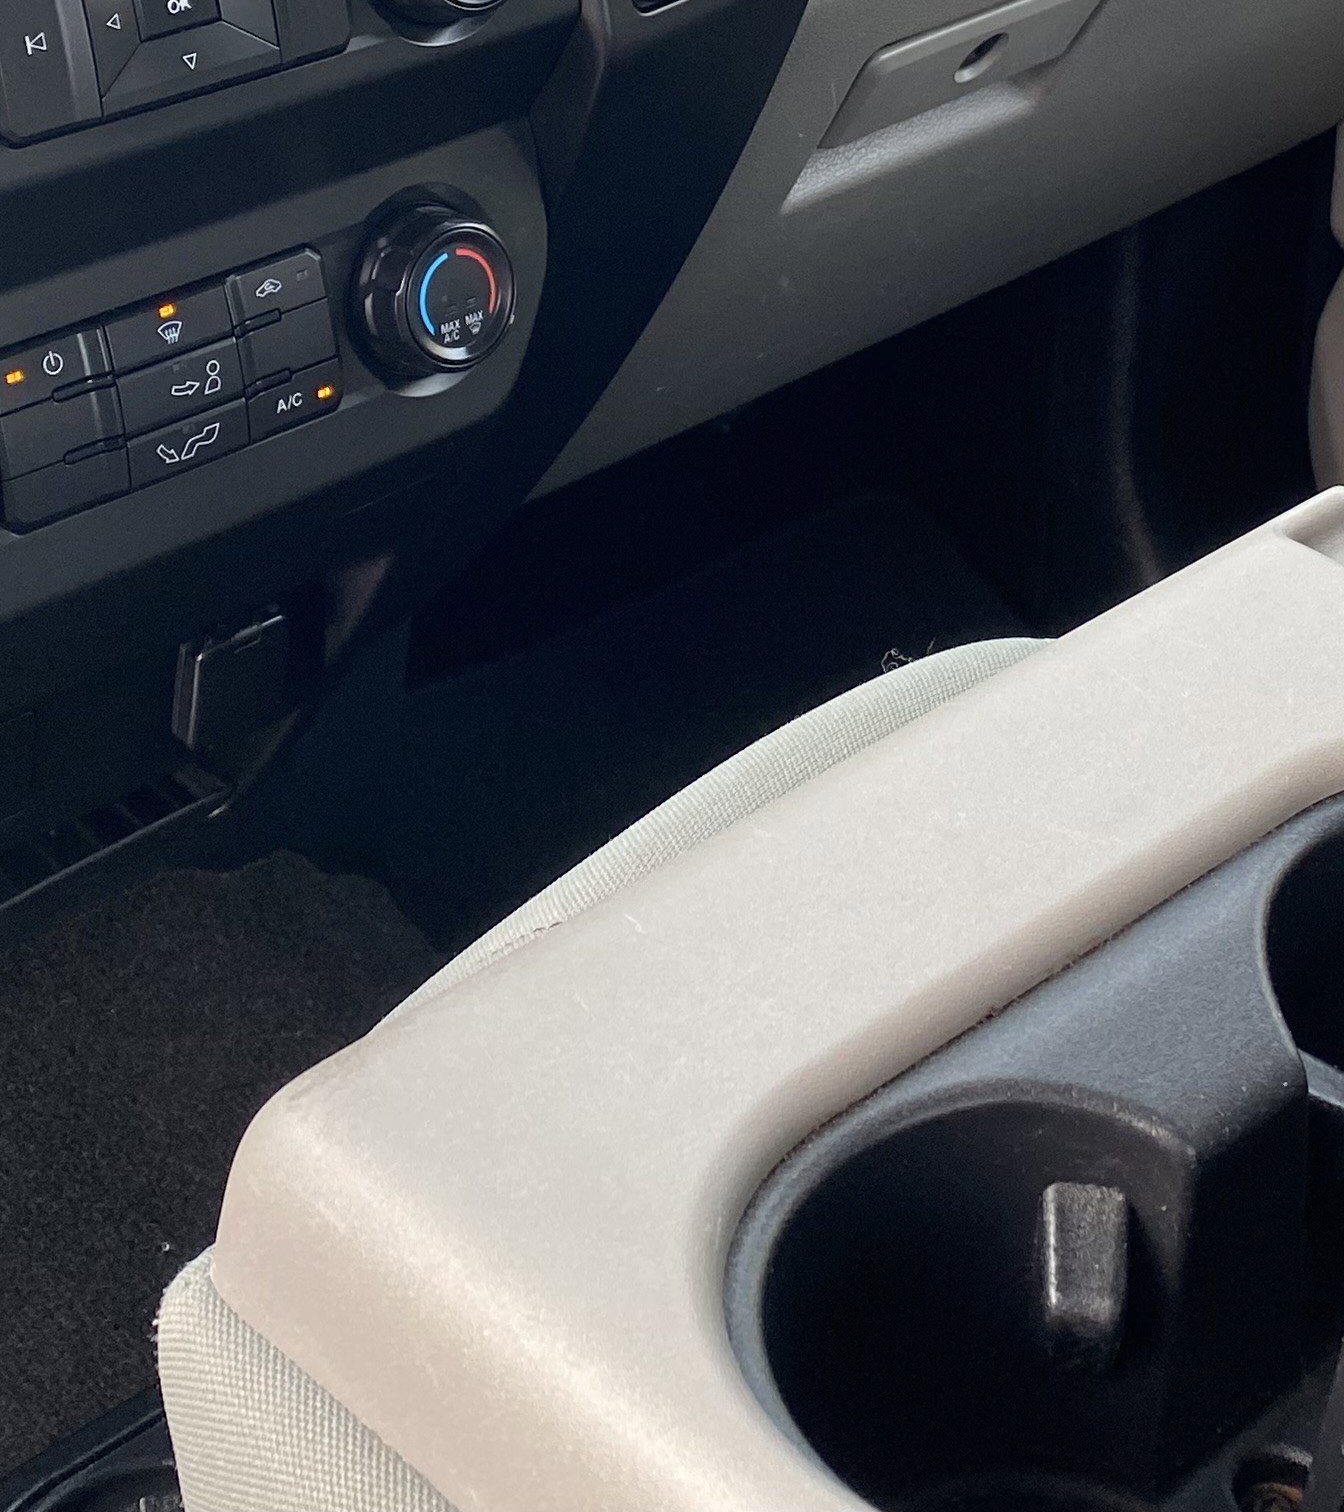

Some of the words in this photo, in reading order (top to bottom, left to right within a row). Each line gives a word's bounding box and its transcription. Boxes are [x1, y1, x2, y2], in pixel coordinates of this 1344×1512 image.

[464, 310, 484, 326] MAX
[440, 318, 461, 335] MAX
[443, 329, 460, 344] A/C
[277, 392, 303, 414] A/C
